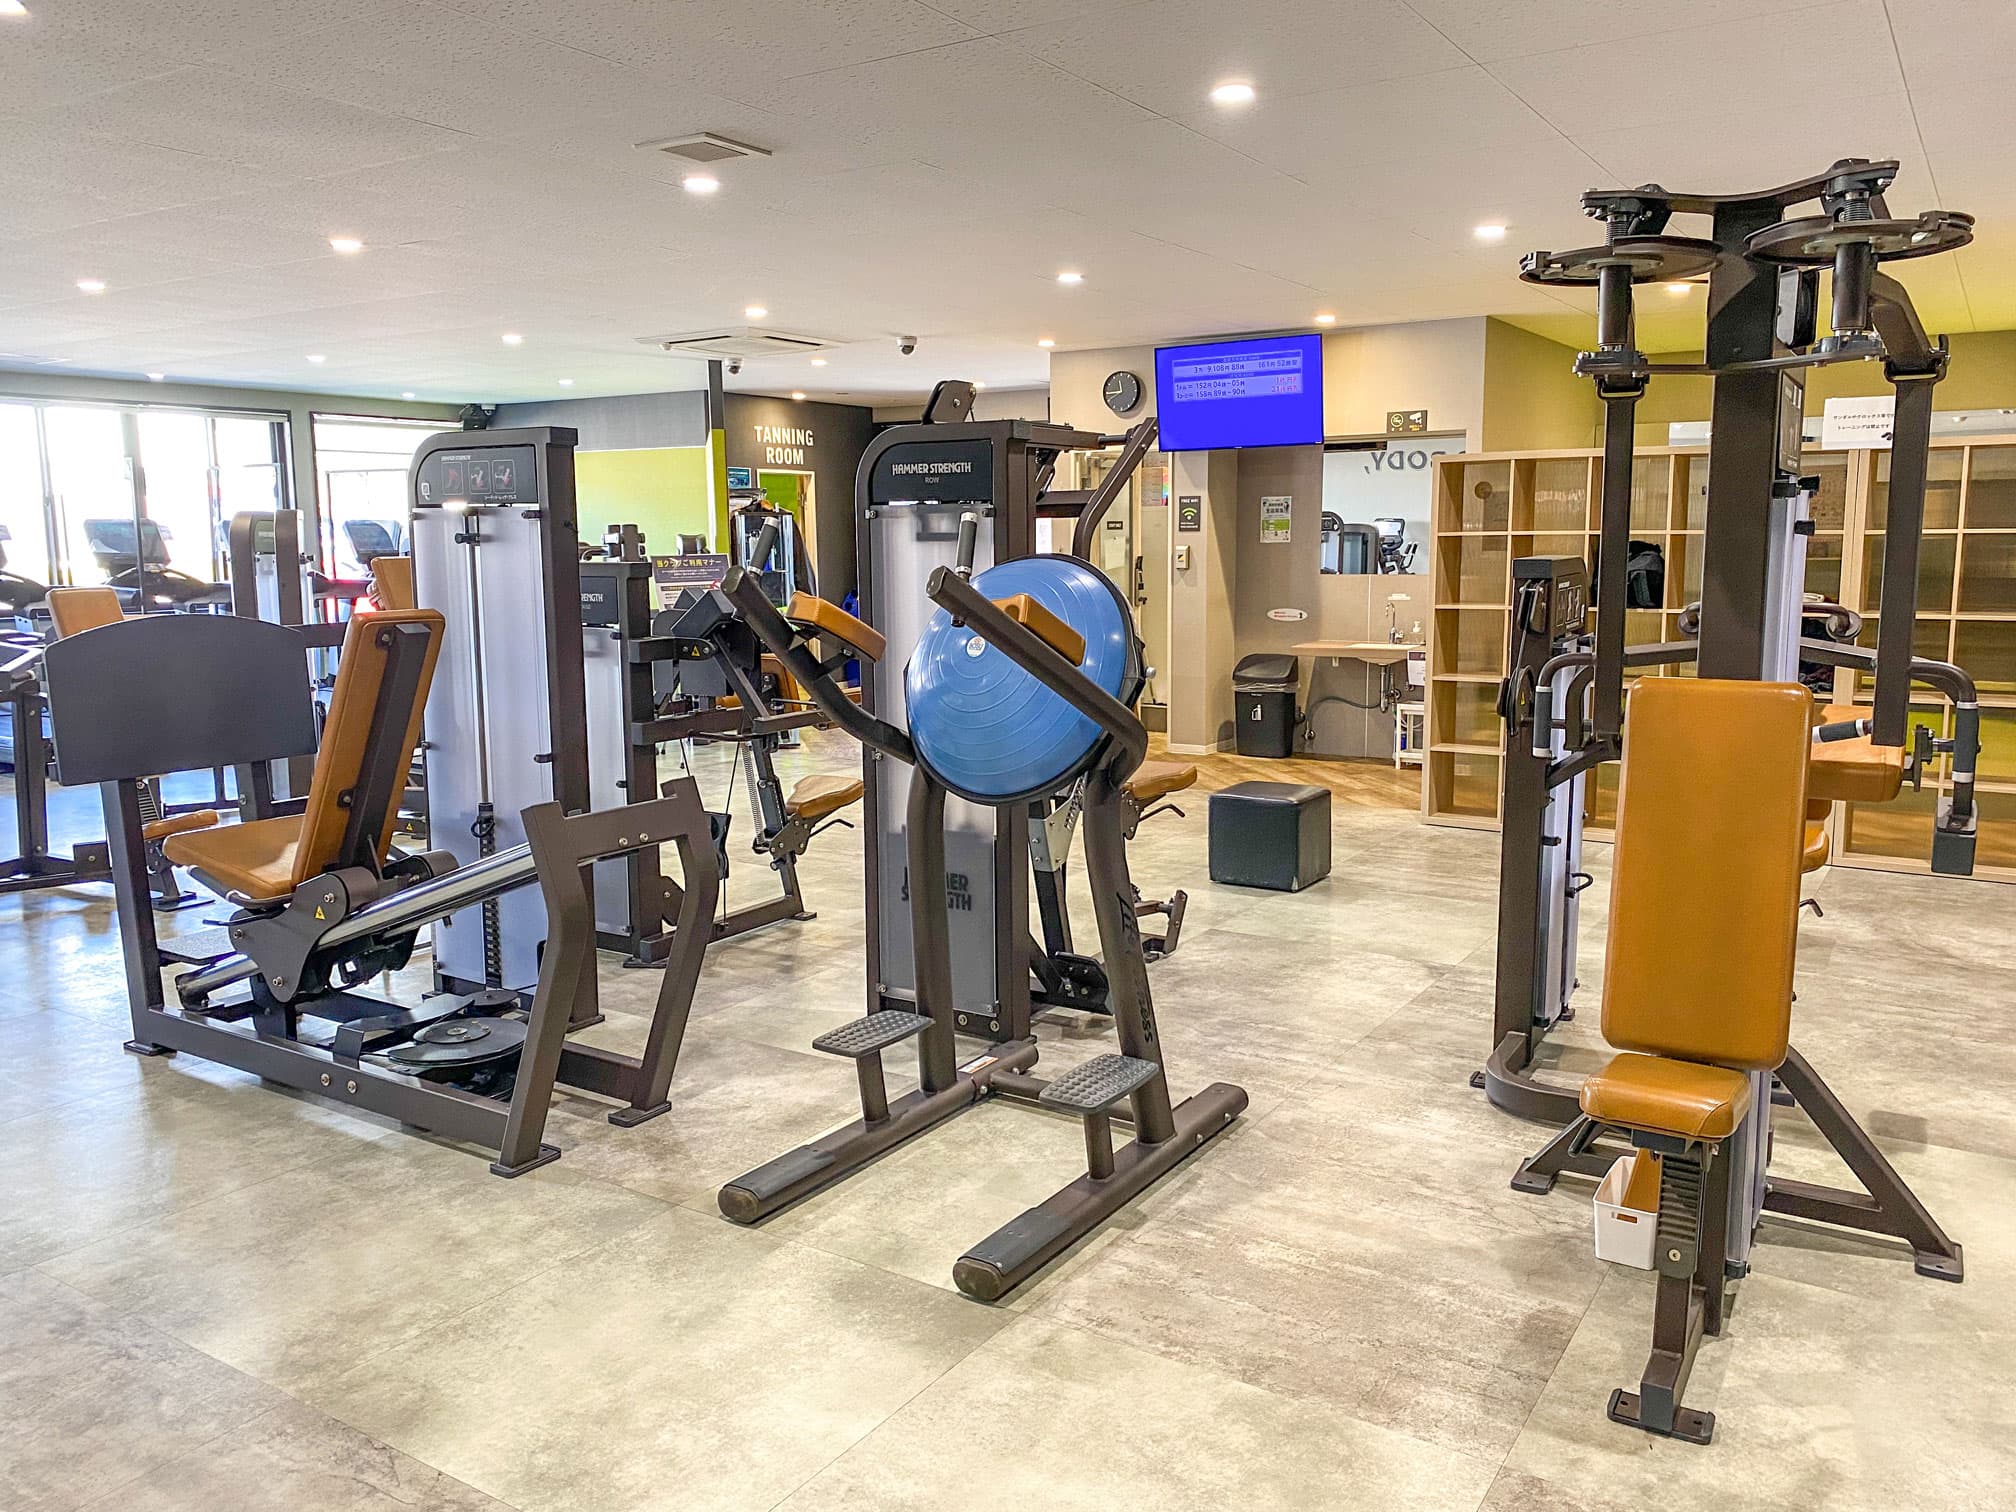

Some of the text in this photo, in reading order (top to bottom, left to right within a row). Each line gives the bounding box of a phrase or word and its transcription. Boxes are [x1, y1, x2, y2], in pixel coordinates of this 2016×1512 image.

[753, 425, 814, 447] TANNING
[765, 446, 804, 465] ROOM
[892, 462, 972, 476] HAMMER STRENGTH
